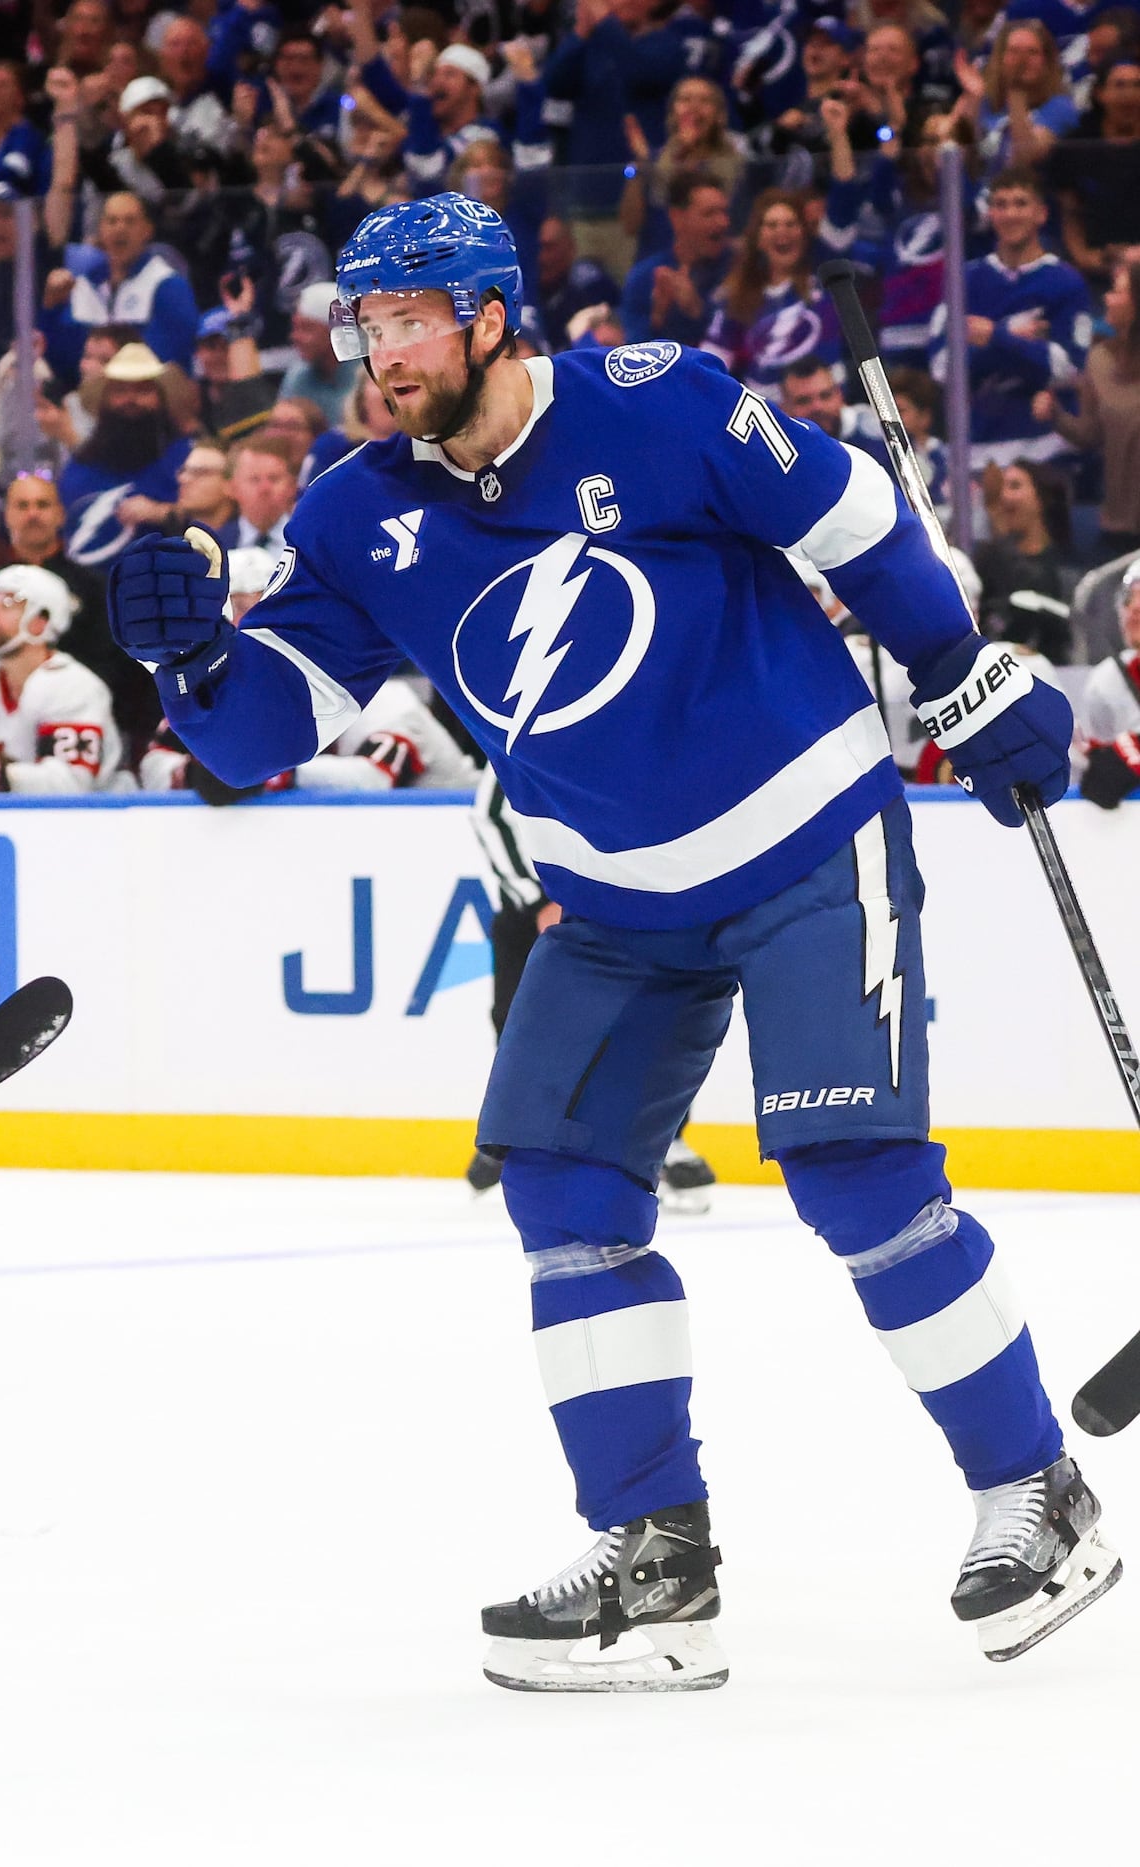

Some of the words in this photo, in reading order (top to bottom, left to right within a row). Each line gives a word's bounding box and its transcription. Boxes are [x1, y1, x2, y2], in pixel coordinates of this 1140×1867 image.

[575, 473, 622, 534] C
[370, 546, 392, 562] the
[53, 726, 100, 765] 23
[368, 732, 408, 774] 71
